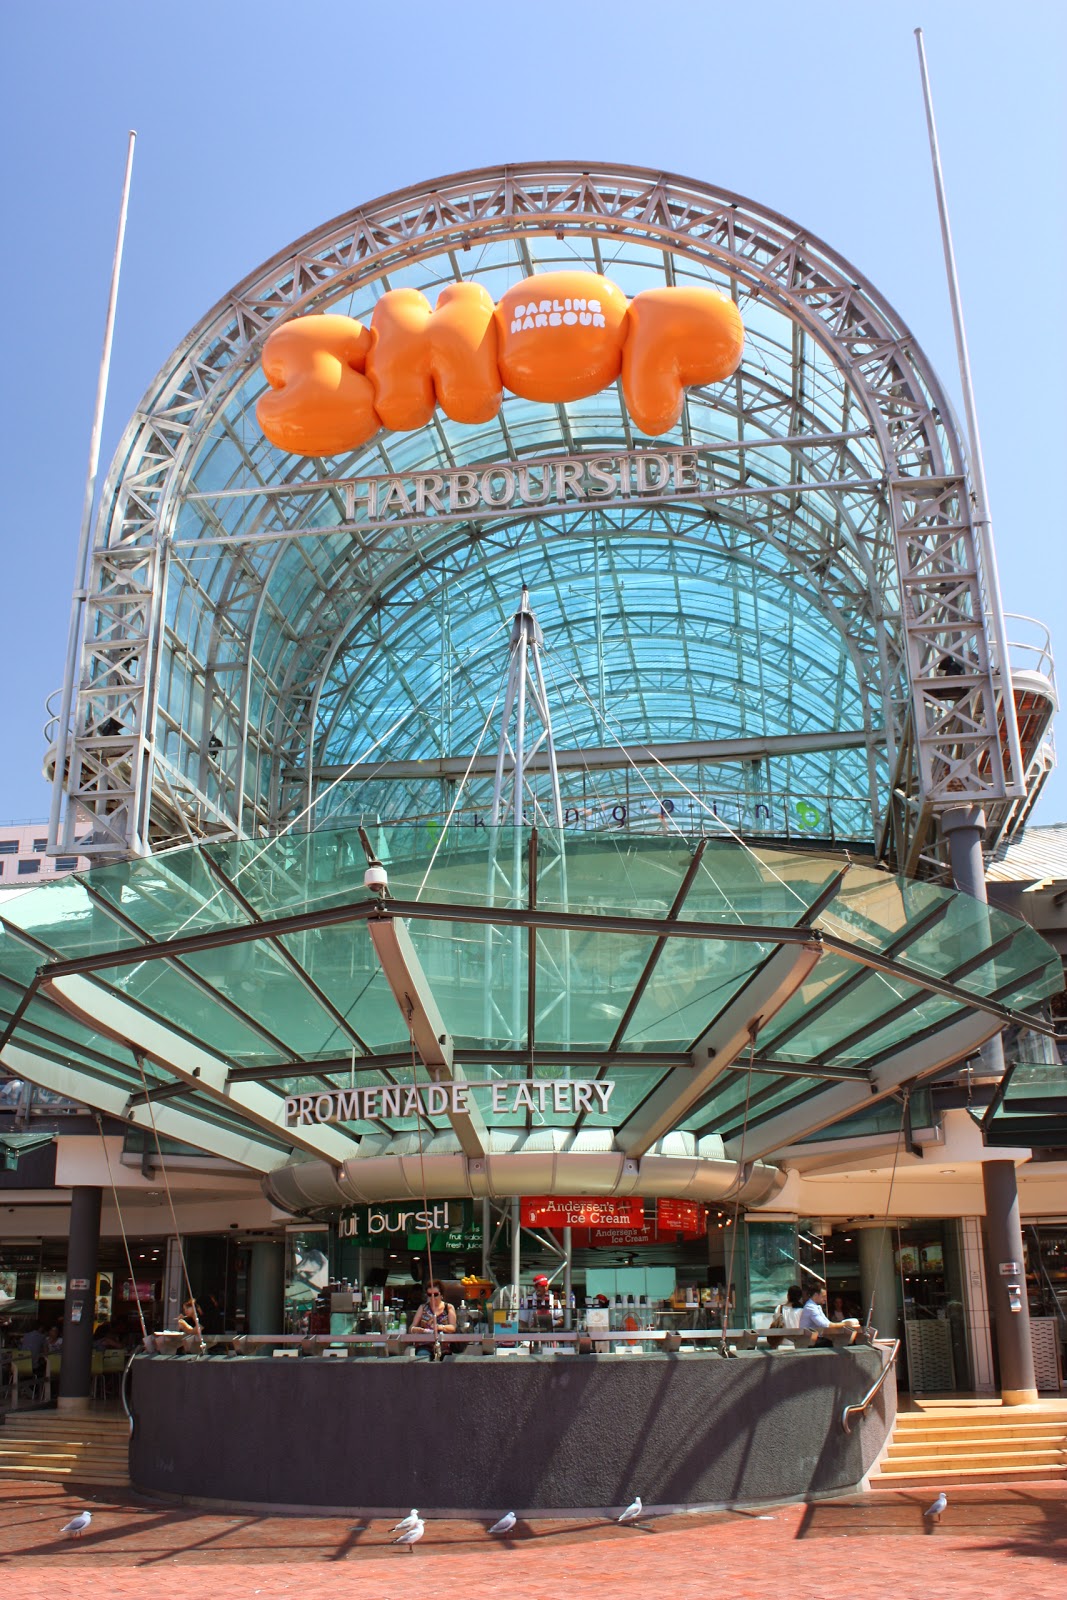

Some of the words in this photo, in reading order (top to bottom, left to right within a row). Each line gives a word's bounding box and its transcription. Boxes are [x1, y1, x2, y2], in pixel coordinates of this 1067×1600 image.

[514, 298, 602, 319] DARLING
[510, 311, 606, 334] HARBOUR
[256, 270, 744, 457] SHOP
[343, 450, 701, 522] HARBOURSIDE
[285, 1083, 470, 1127] PROMENADE
[492, 1080, 616, 1115] EATERY
[368, 1201, 449, 1234] burst!
[545, 1200, 615, 1213] Andersen's
[566, 1212, 586, 1224] Ice
[589, 1212, 631, 1224] Cream
[595, 1228, 638, 1238] Andersen's
[611, 1235, 624, 1244] Ice
[624, 1234, 649, 1243] Cream
